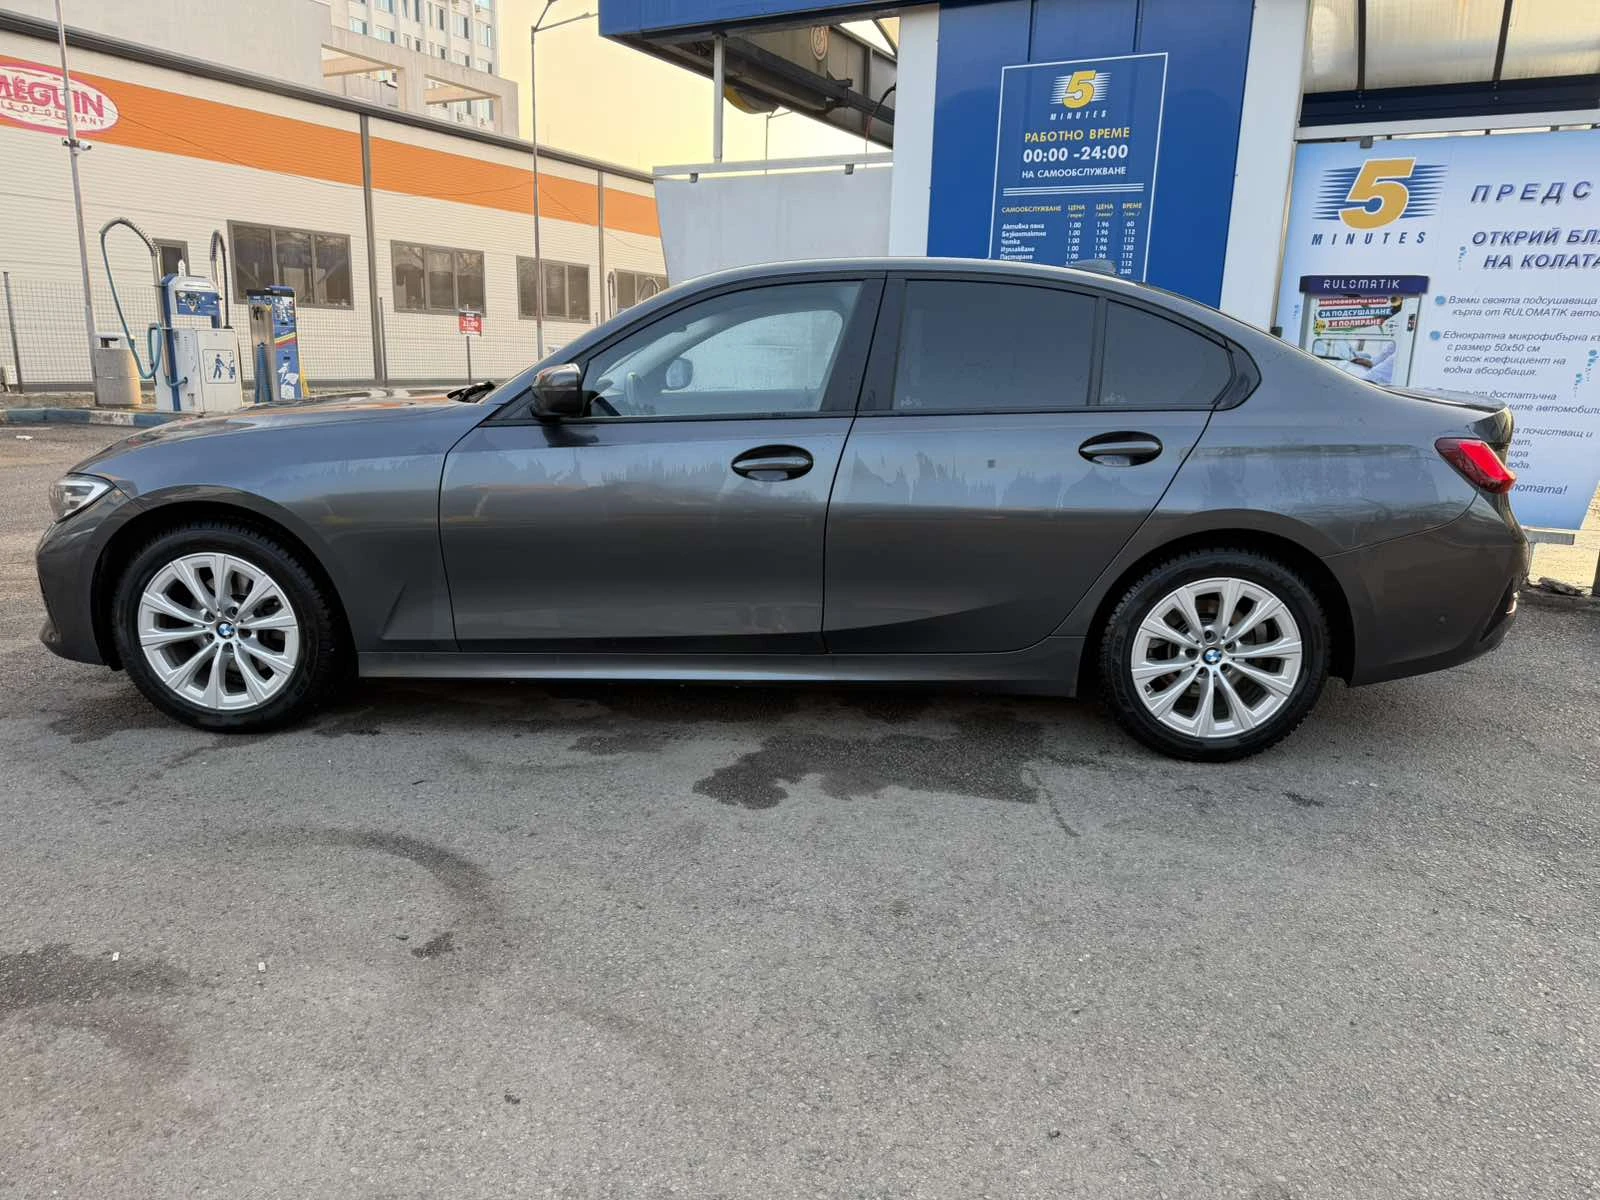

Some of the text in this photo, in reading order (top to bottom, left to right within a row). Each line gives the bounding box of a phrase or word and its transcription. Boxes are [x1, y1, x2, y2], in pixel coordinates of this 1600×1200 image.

[1062, 70, 1096, 108] 5
[1050, 110, 1107, 120] MINUTES
[1024, 127, 1131, 142] РАБОТНО ВРЕМЕ
[1023, 147, 1068, 163] 00:00
[1022, 167, 1127, 178] НА САМООБСЛУЖВАНЕ
[1338, 157, 1416, 230] 5
[1470, 181, 1592, 204] ПРЕДС
[1311, 232, 1426, 245] MINUTES
[1472, 227, 1600, 245] ОТКРИЙ БЛ
[1483, 253, 1512, 268] НА
[1323, 279, 1400, 289] RULOMATIK
[1448, 296, 1480, 304] Вземи
[1332, 308, 1391, 317] ПОДСУШАВАНЕ
[1452, 308, 1482, 318] кърпа
[1503, 307, 1567, 317] RULOMATIK
[1338, 318, 1381, 327] ПОЛИРАНЕ
[1443, 330, 1506, 341] Еднократна
[1508, 331, 1588, 342] микрофибърна
[1454, 344, 1491, 352] размер
[1452, 355, 1481, 363] висок
[1483, 355, 1551, 368] коефициент
[1552, 357, 1566, 365] на
[1443, 365, 1473, 374] водна
[1489, 389, 1557, 401] достатъчна
[1522, 427, 1583, 438] почистващ
